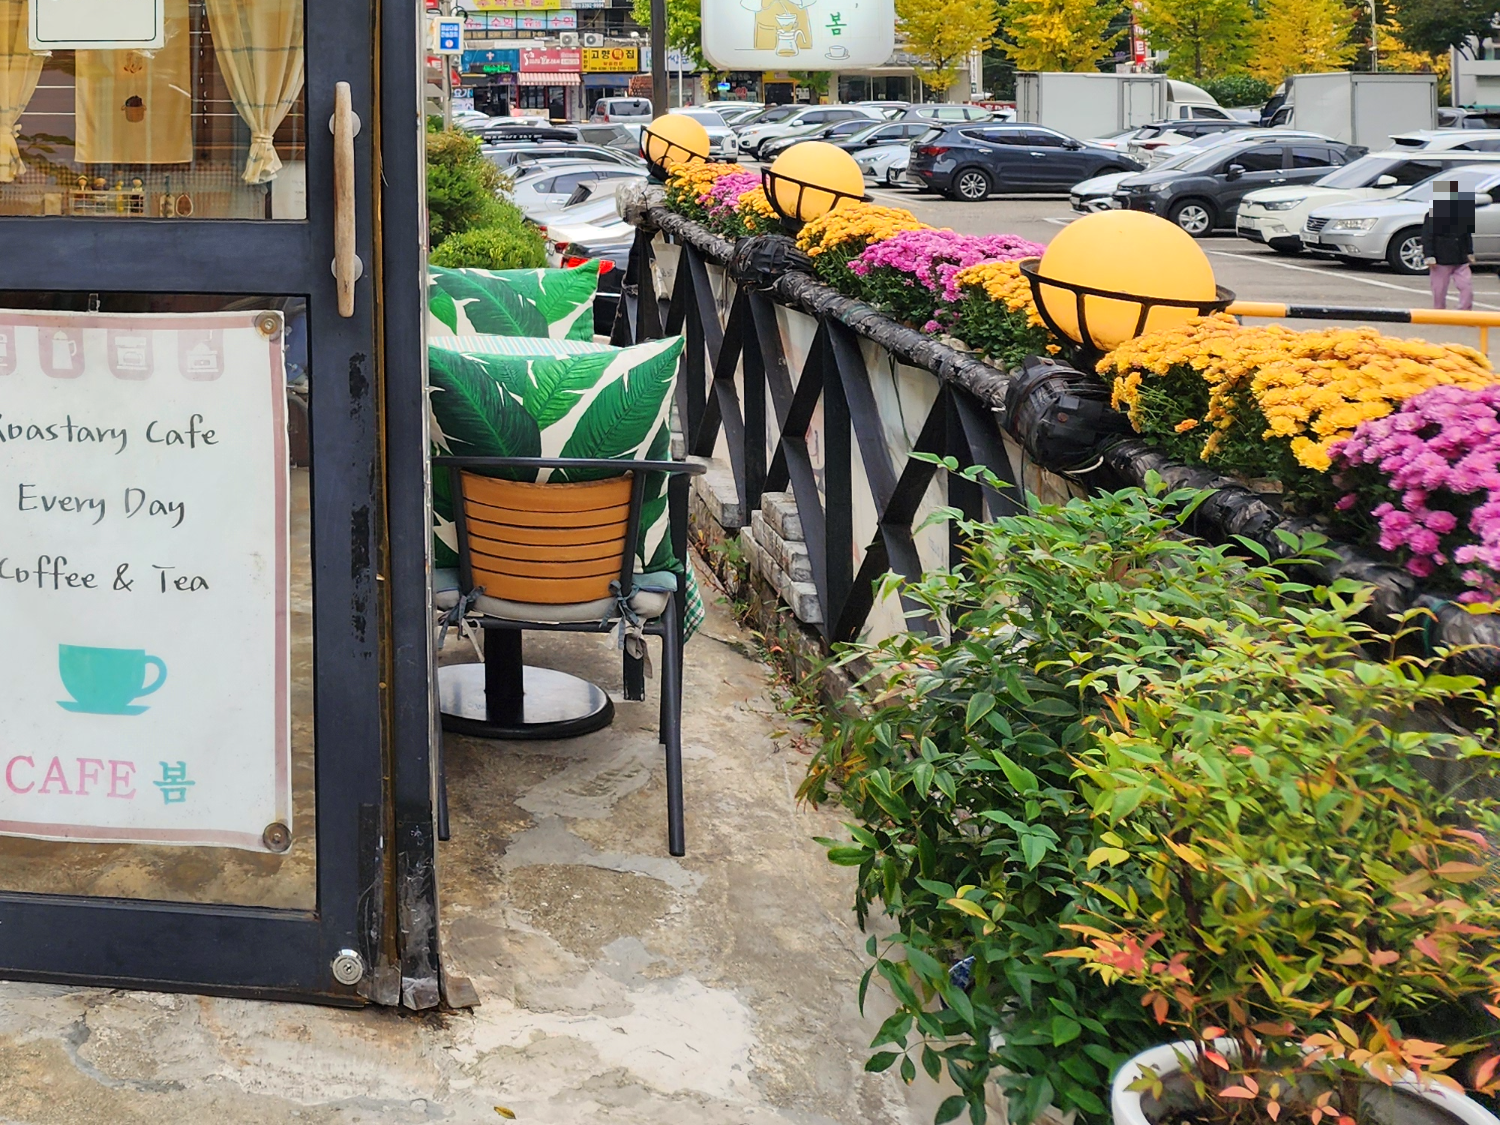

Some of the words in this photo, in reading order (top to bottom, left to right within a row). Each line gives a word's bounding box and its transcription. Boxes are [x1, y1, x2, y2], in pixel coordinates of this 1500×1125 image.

[825, 11, 847, 36] 봄
[146, 413, 219, 449] Cafe
[17, 483, 106, 525] Every
[124, 487, 185, 529] Day
[113, 563, 134, 592] &
[152, 564, 210, 594] Tea
[6, 755, 138, 800] CAFE
[153, 760, 196, 805] 봄
